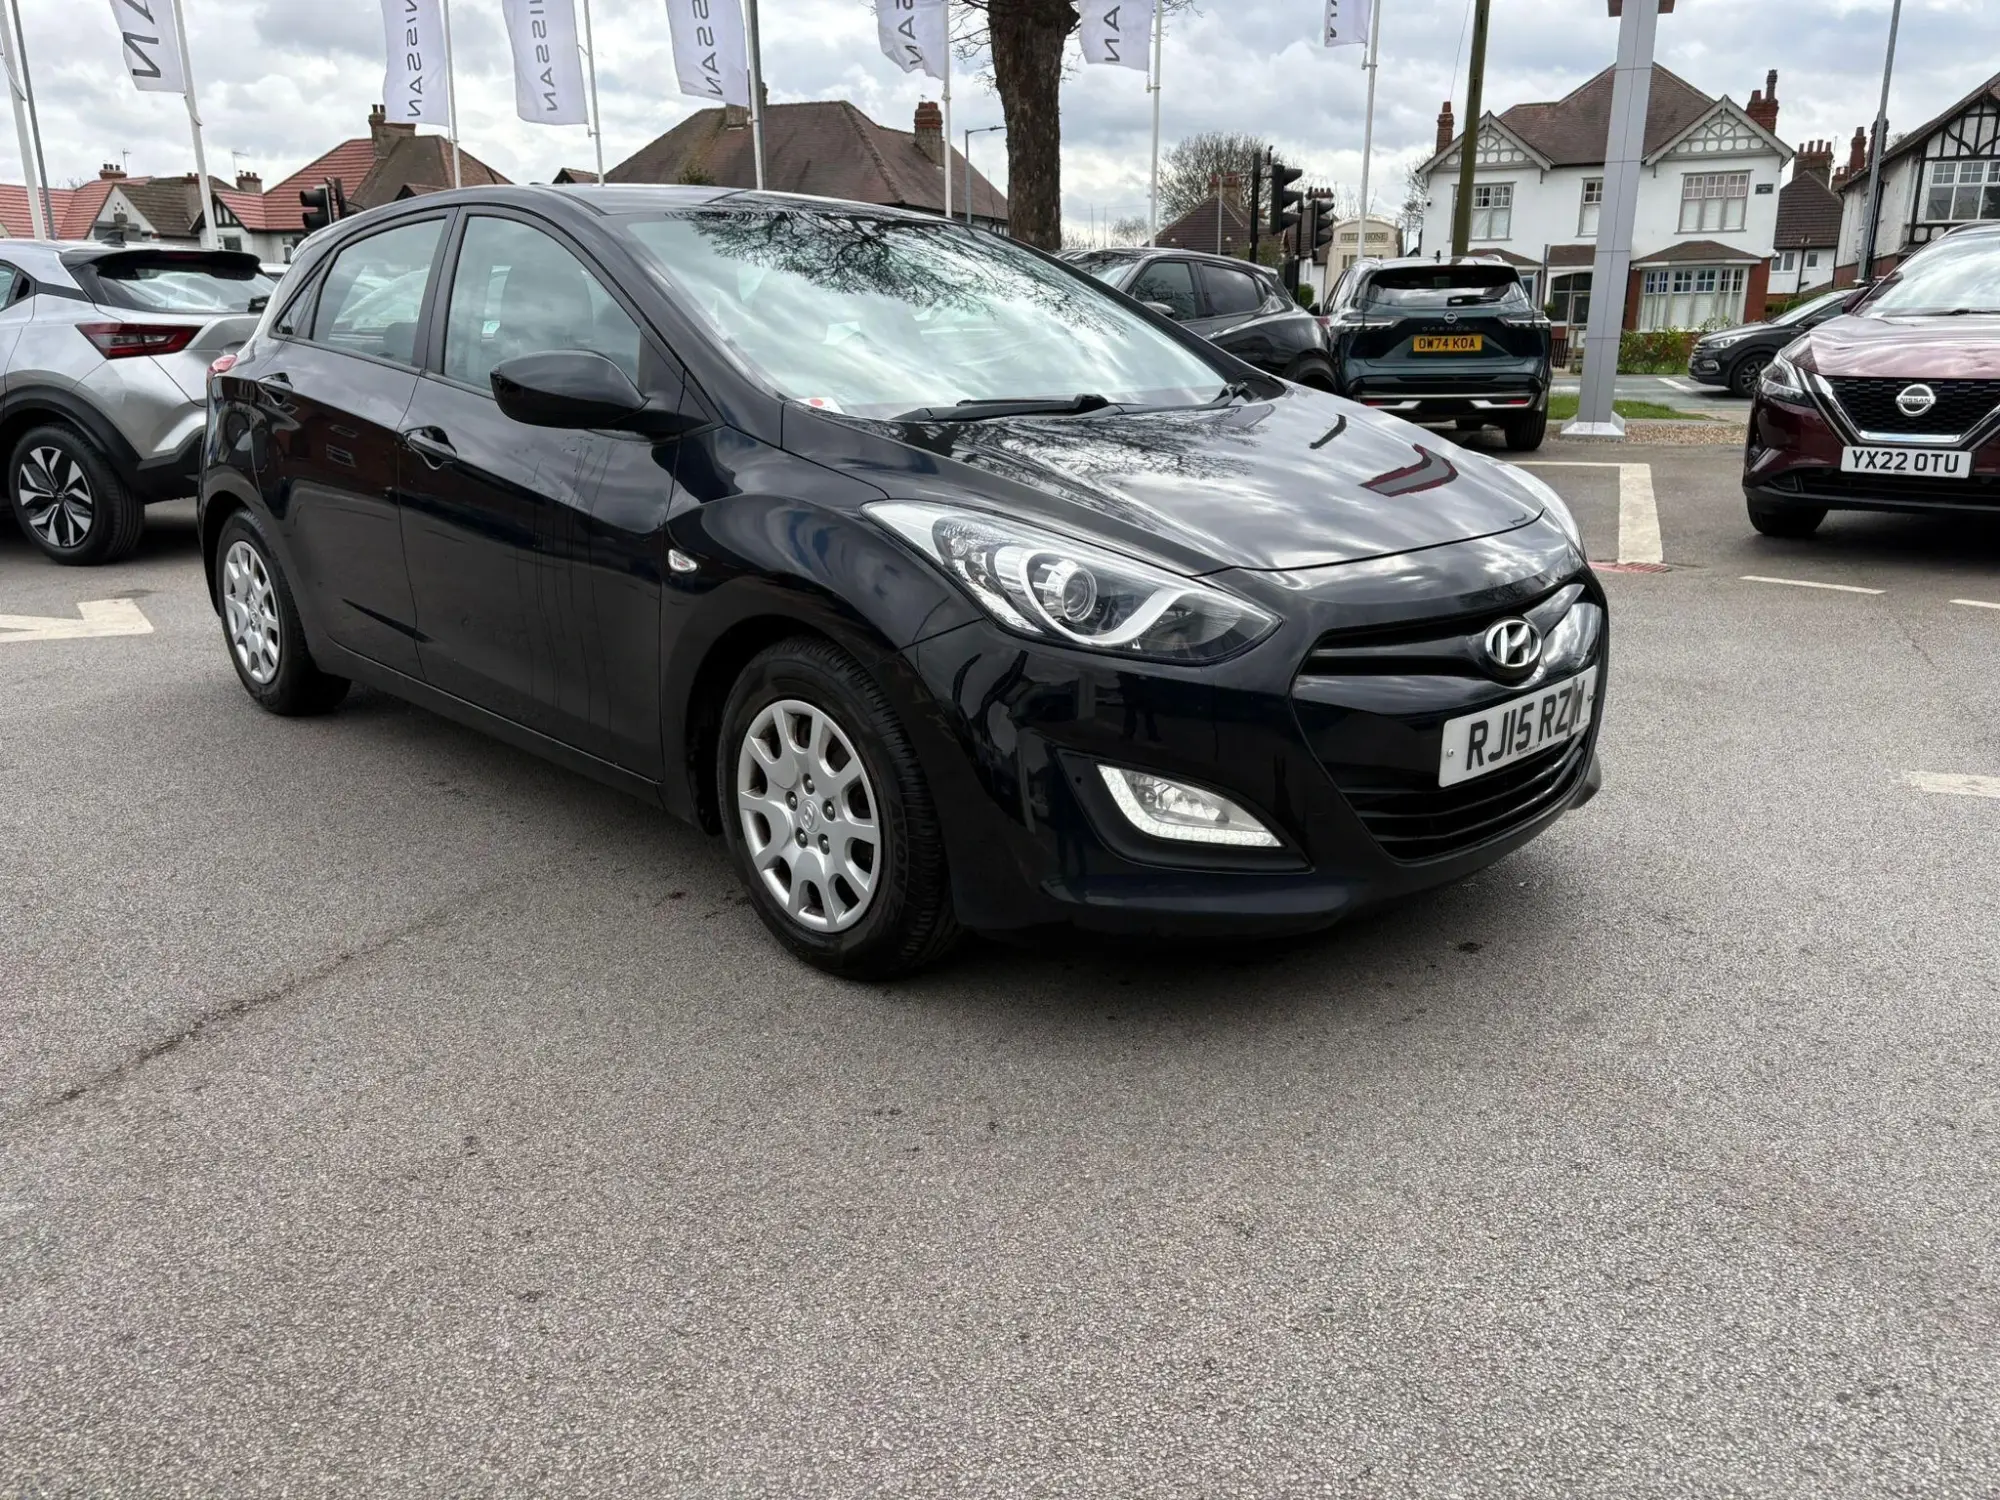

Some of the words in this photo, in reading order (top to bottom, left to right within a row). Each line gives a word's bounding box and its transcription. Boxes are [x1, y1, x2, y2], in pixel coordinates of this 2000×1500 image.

[1452, 337, 1476, 349] KOA
[1852, 449, 1908, 471] YX22
[1913, 453, 1960, 474] OTU
[1465, 701, 1535, 772] RJ15
